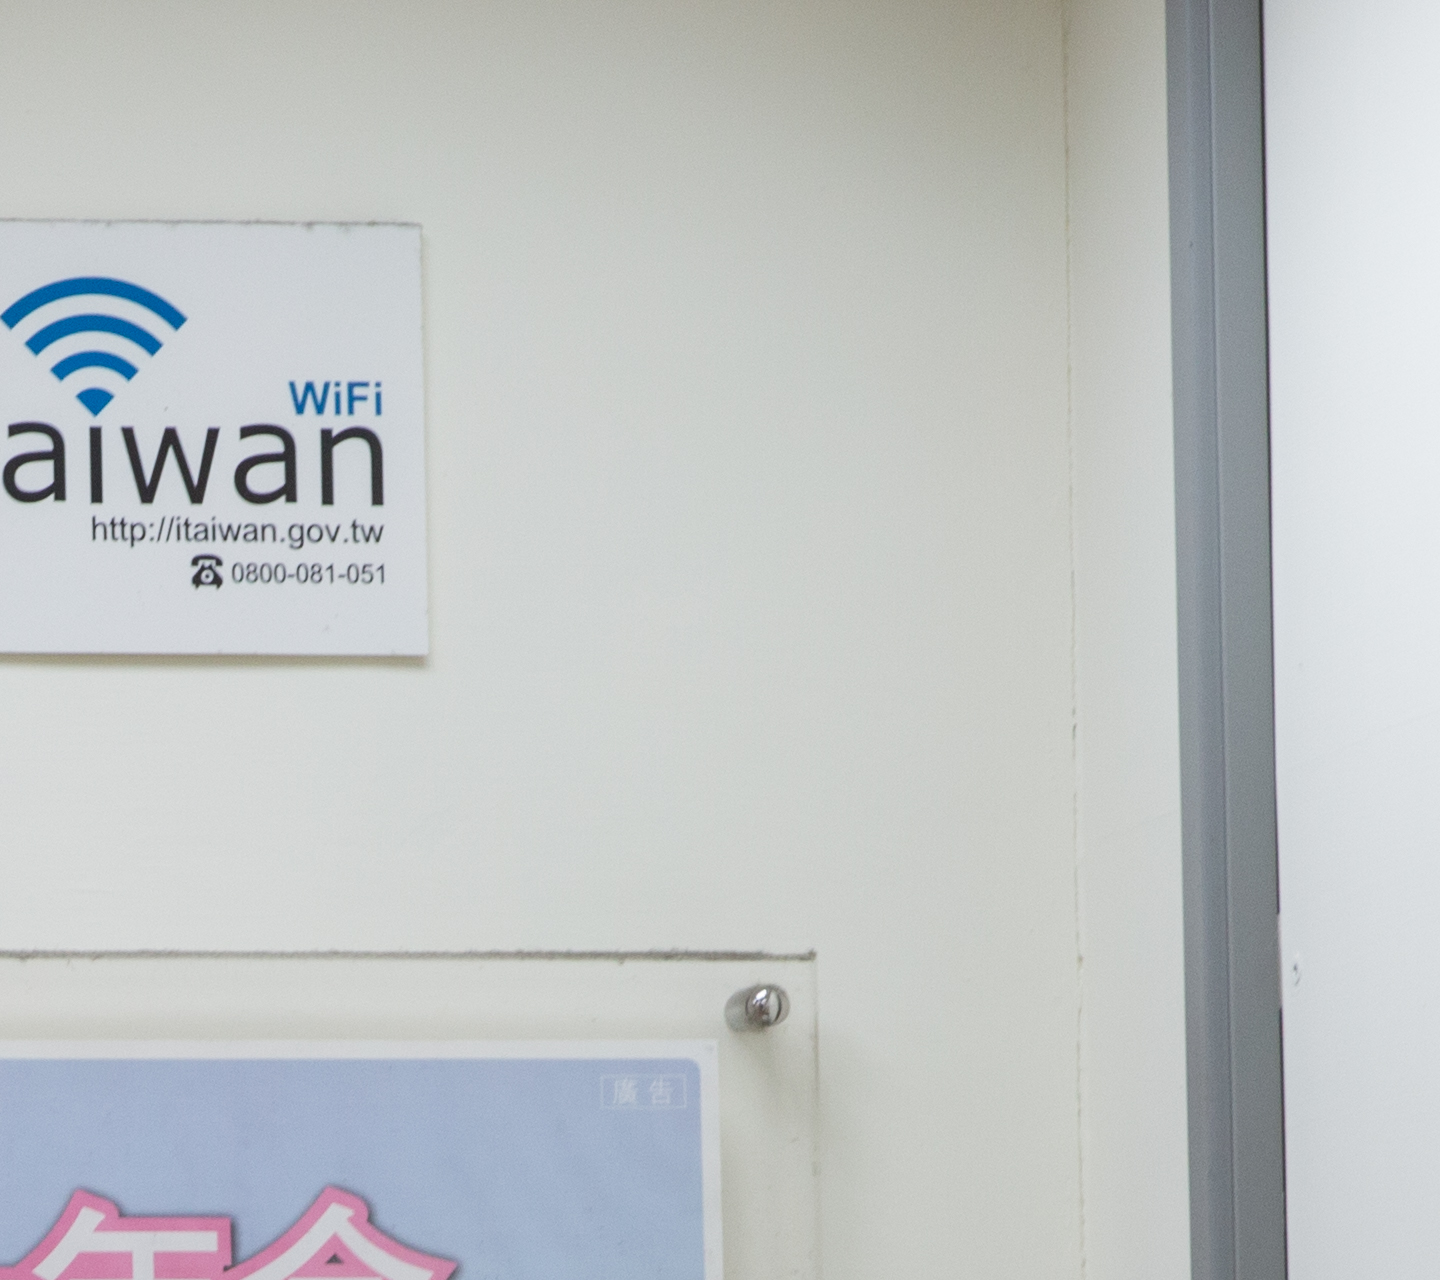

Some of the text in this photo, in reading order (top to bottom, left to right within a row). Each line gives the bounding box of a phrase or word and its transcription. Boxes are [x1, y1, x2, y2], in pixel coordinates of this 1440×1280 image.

[288, 380, 384, 417] WiFi
[90, 515, 385, 550] http://itaiwan.gov.tw
[230, 562, 387, 586] 0800-081-051
